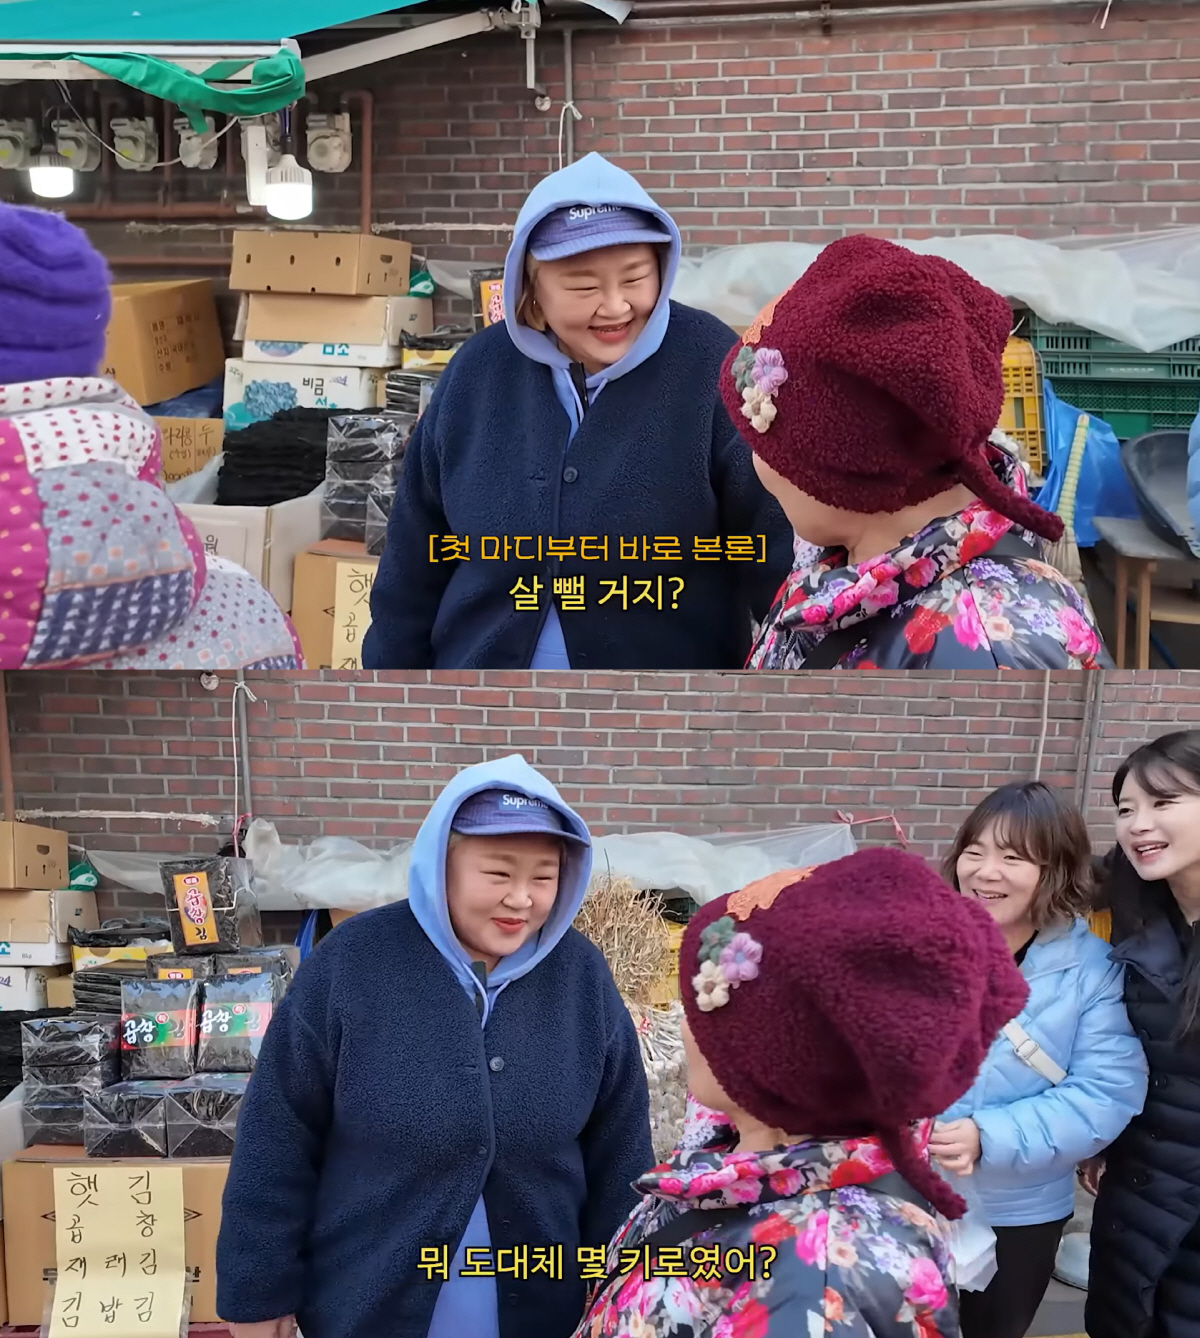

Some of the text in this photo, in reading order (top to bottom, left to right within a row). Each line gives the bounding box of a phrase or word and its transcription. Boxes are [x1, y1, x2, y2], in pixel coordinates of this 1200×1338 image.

[303, 377, 325, 396] 비금
[122, 1017, 157, 1045] 곱창
[199, 1008, 233, 1034] 곱창
